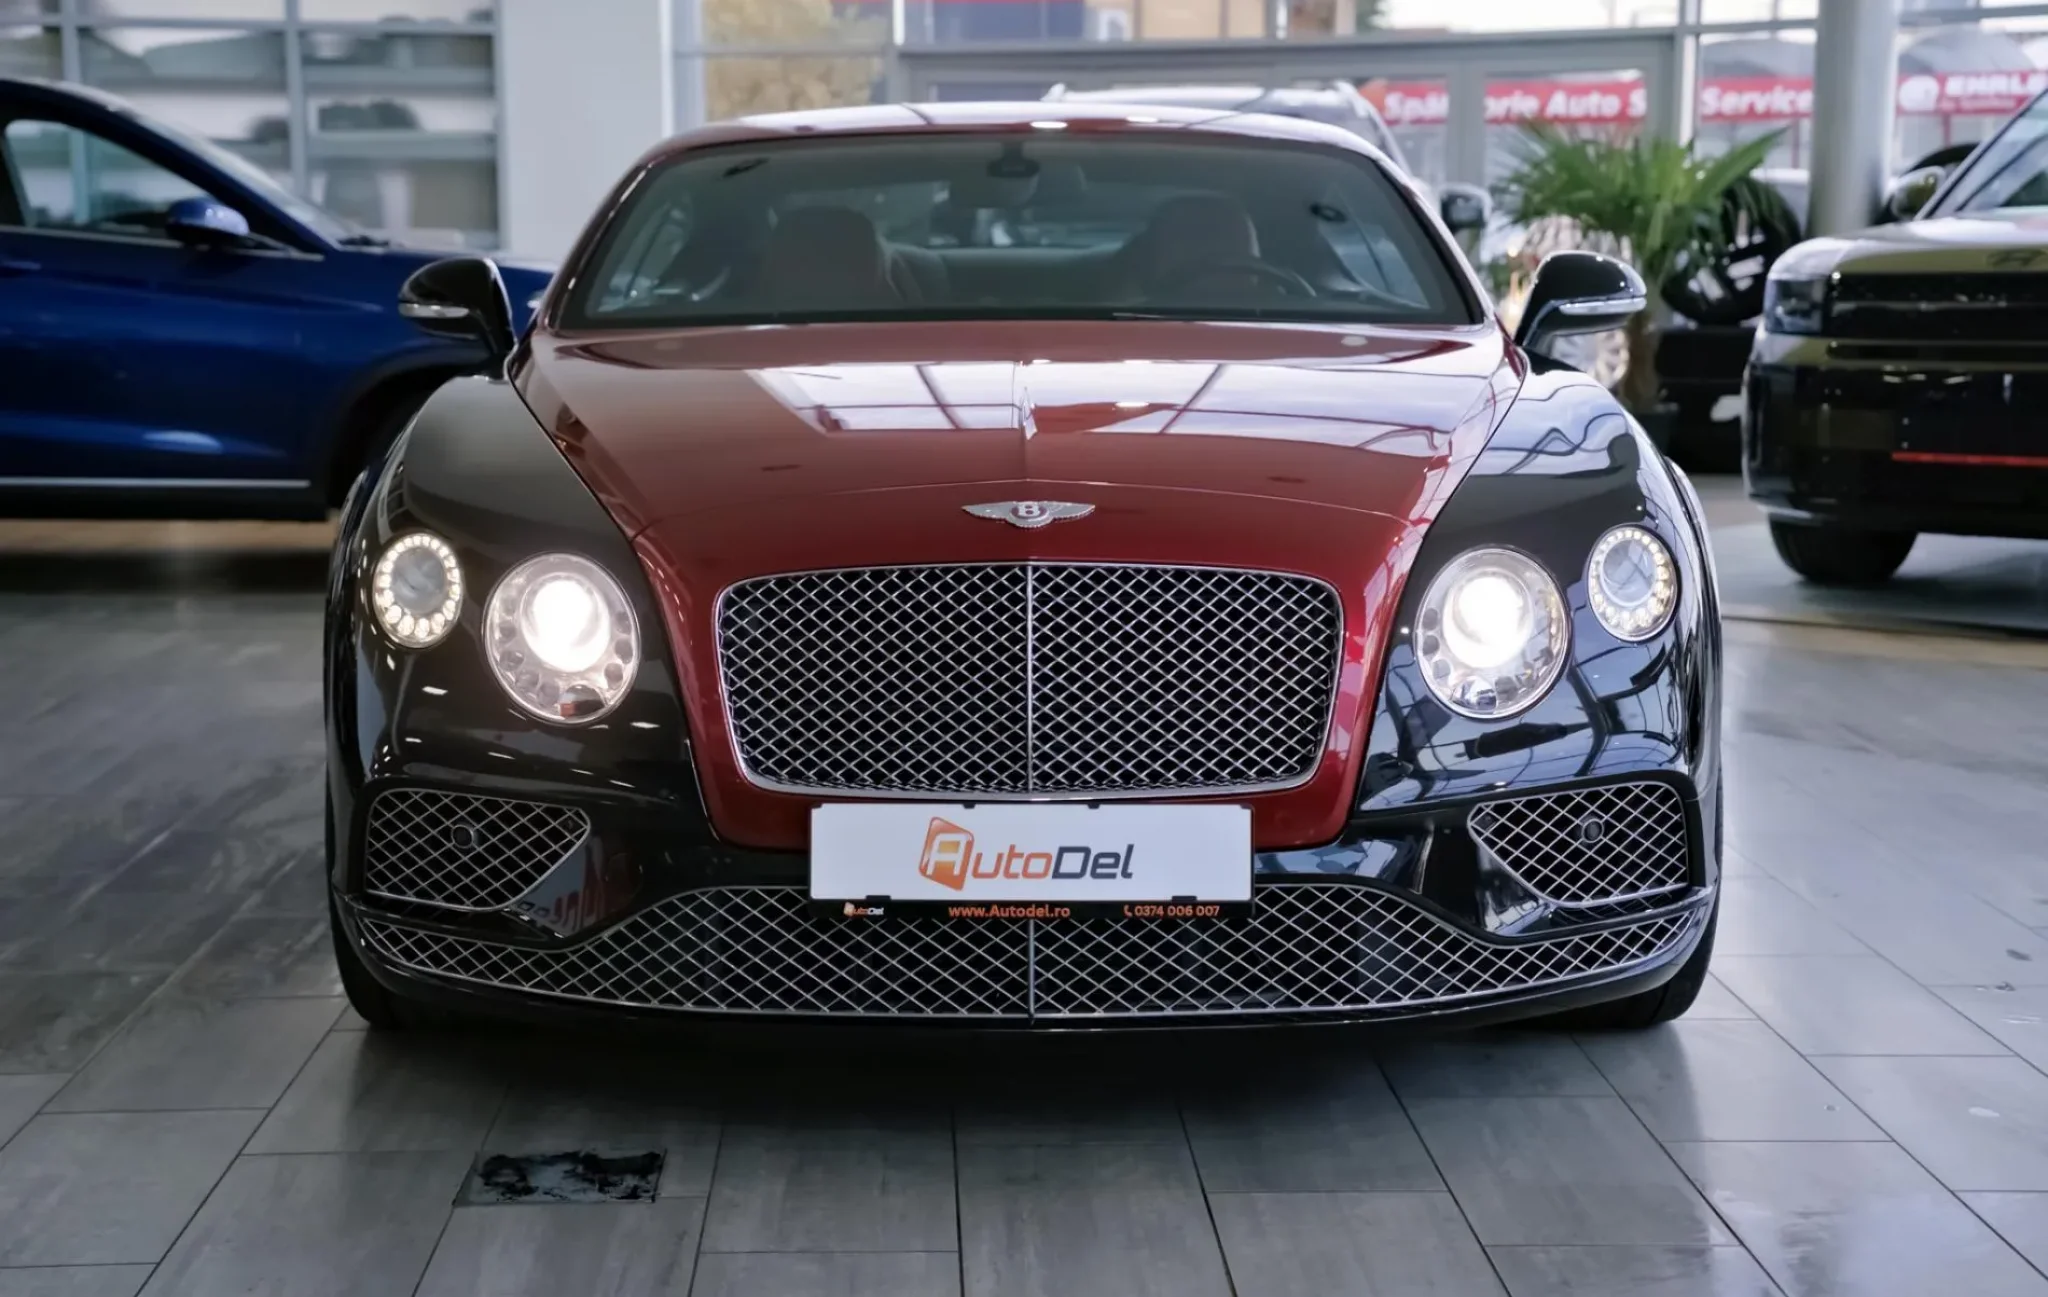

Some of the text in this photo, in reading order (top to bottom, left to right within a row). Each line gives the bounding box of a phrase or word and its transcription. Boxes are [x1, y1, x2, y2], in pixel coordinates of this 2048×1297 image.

[1546, 90, 1621, 118] Auto
[920, 820, 1135, 888] AutoDel
[948, 904, 1071, 917] www.Autodel.ro
[1134, 905, 1220, 917] 0374 006 007
